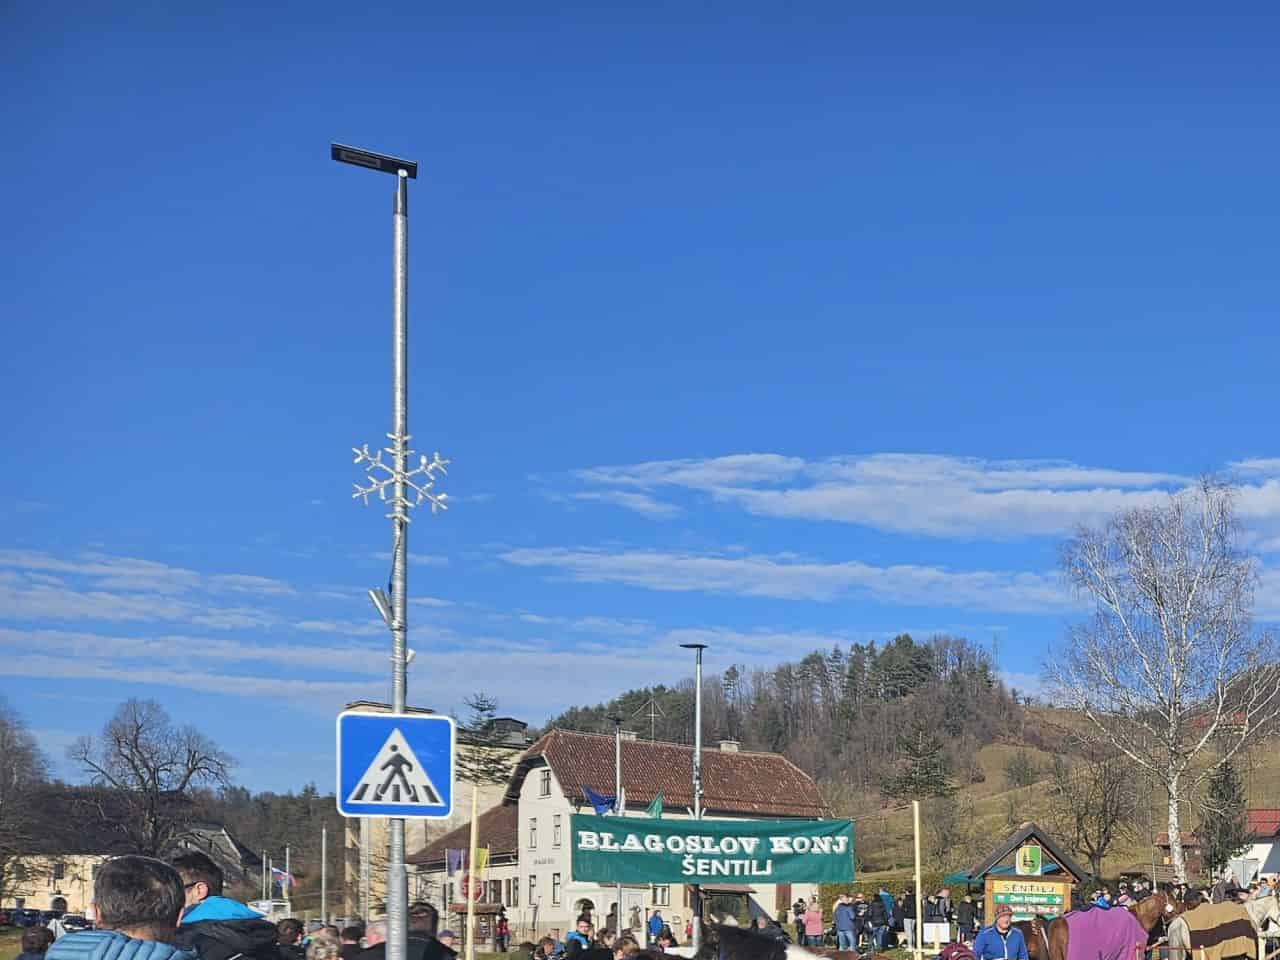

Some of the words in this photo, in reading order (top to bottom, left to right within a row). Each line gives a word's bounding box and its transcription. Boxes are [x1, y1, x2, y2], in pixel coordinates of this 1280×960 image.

[577, 831, 760, 855] BLAGOSLOV
[769, 835, 849, 855] KONJ
[681, 855, 772, 876] ŠENTILJ
